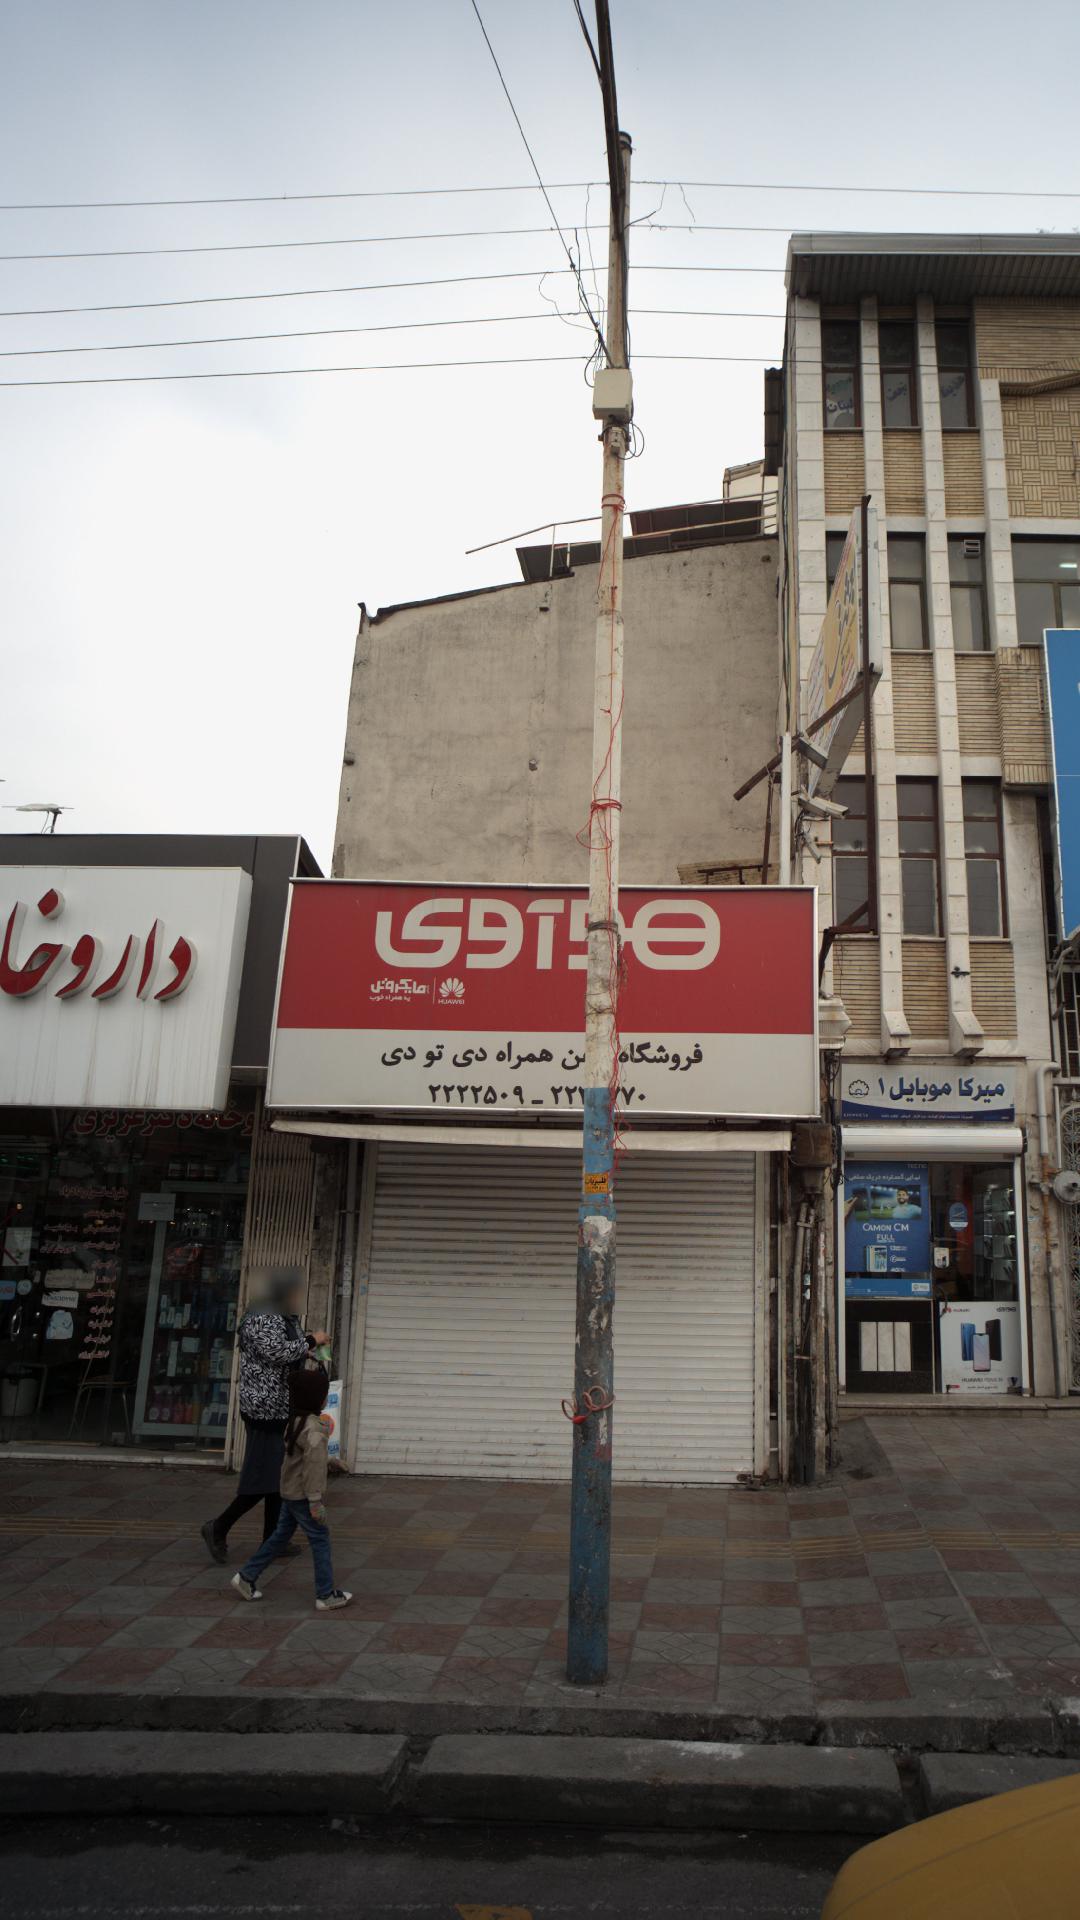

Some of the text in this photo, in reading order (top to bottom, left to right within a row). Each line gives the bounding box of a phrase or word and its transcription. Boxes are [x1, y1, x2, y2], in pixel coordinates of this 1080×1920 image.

[381, 1045, 416, 1067] دی
[423, 1044, 445, 1068] تو
[452, 1047, 488, 1068] دی
[496, 1041, 554, 1069] همراه
[618, 1042, 704, 1071] فروشگاه
[428, 1084, 524, 1105] ۲۲۲۲۵۰۹
[550, 1085, 646, 1106] ۲۲۲۷۰
[889, 1077, 952, 1103] موبایل
[958, 1078, 1005, 1103] میرکا
[893, 1222, 909, 1232] CM
